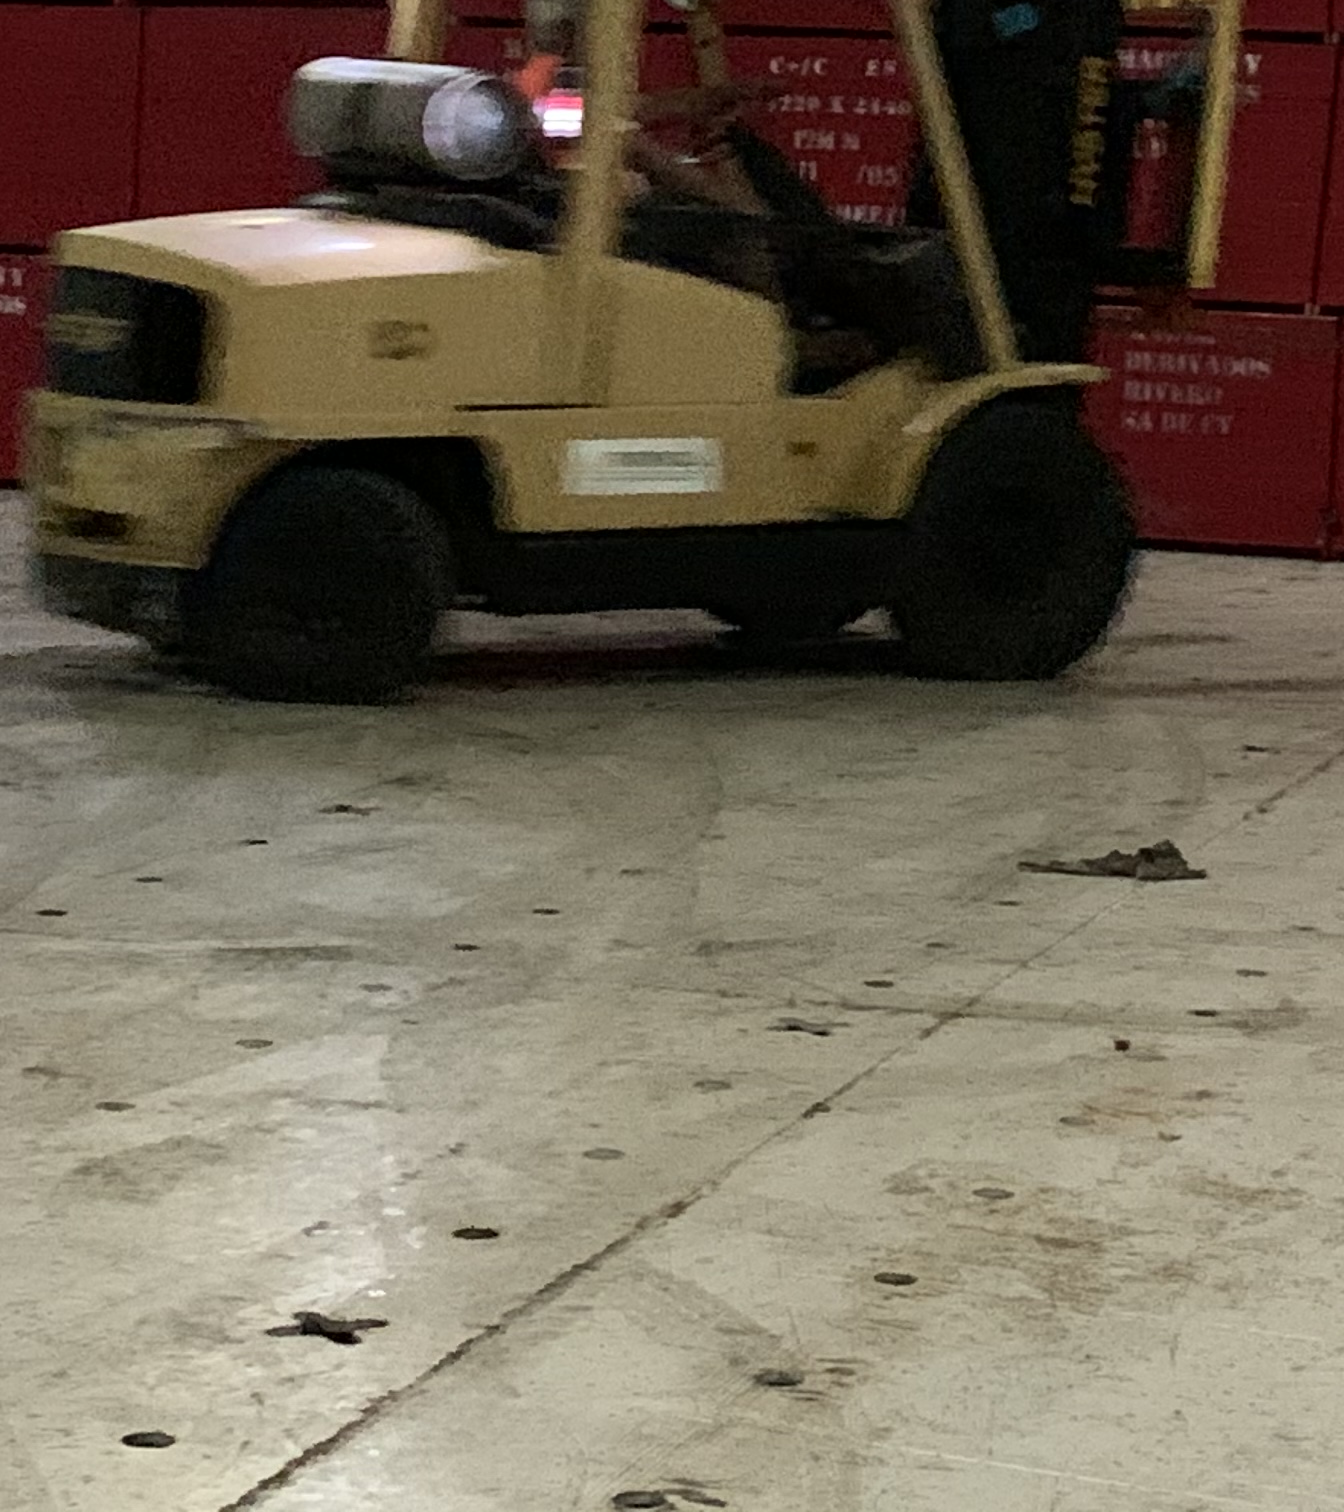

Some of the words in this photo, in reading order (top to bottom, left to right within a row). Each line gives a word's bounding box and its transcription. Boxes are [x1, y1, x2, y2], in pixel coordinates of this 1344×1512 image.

[769, 56, 828, 77] C+/C
[864, 58, 898, 77] ES
[1245, 53, 1263, 76] Y
[828, 96, 845, 114] X
[852, 96, 914, 116] 2440
[1124, 380, 1224, 405] RIVERO
